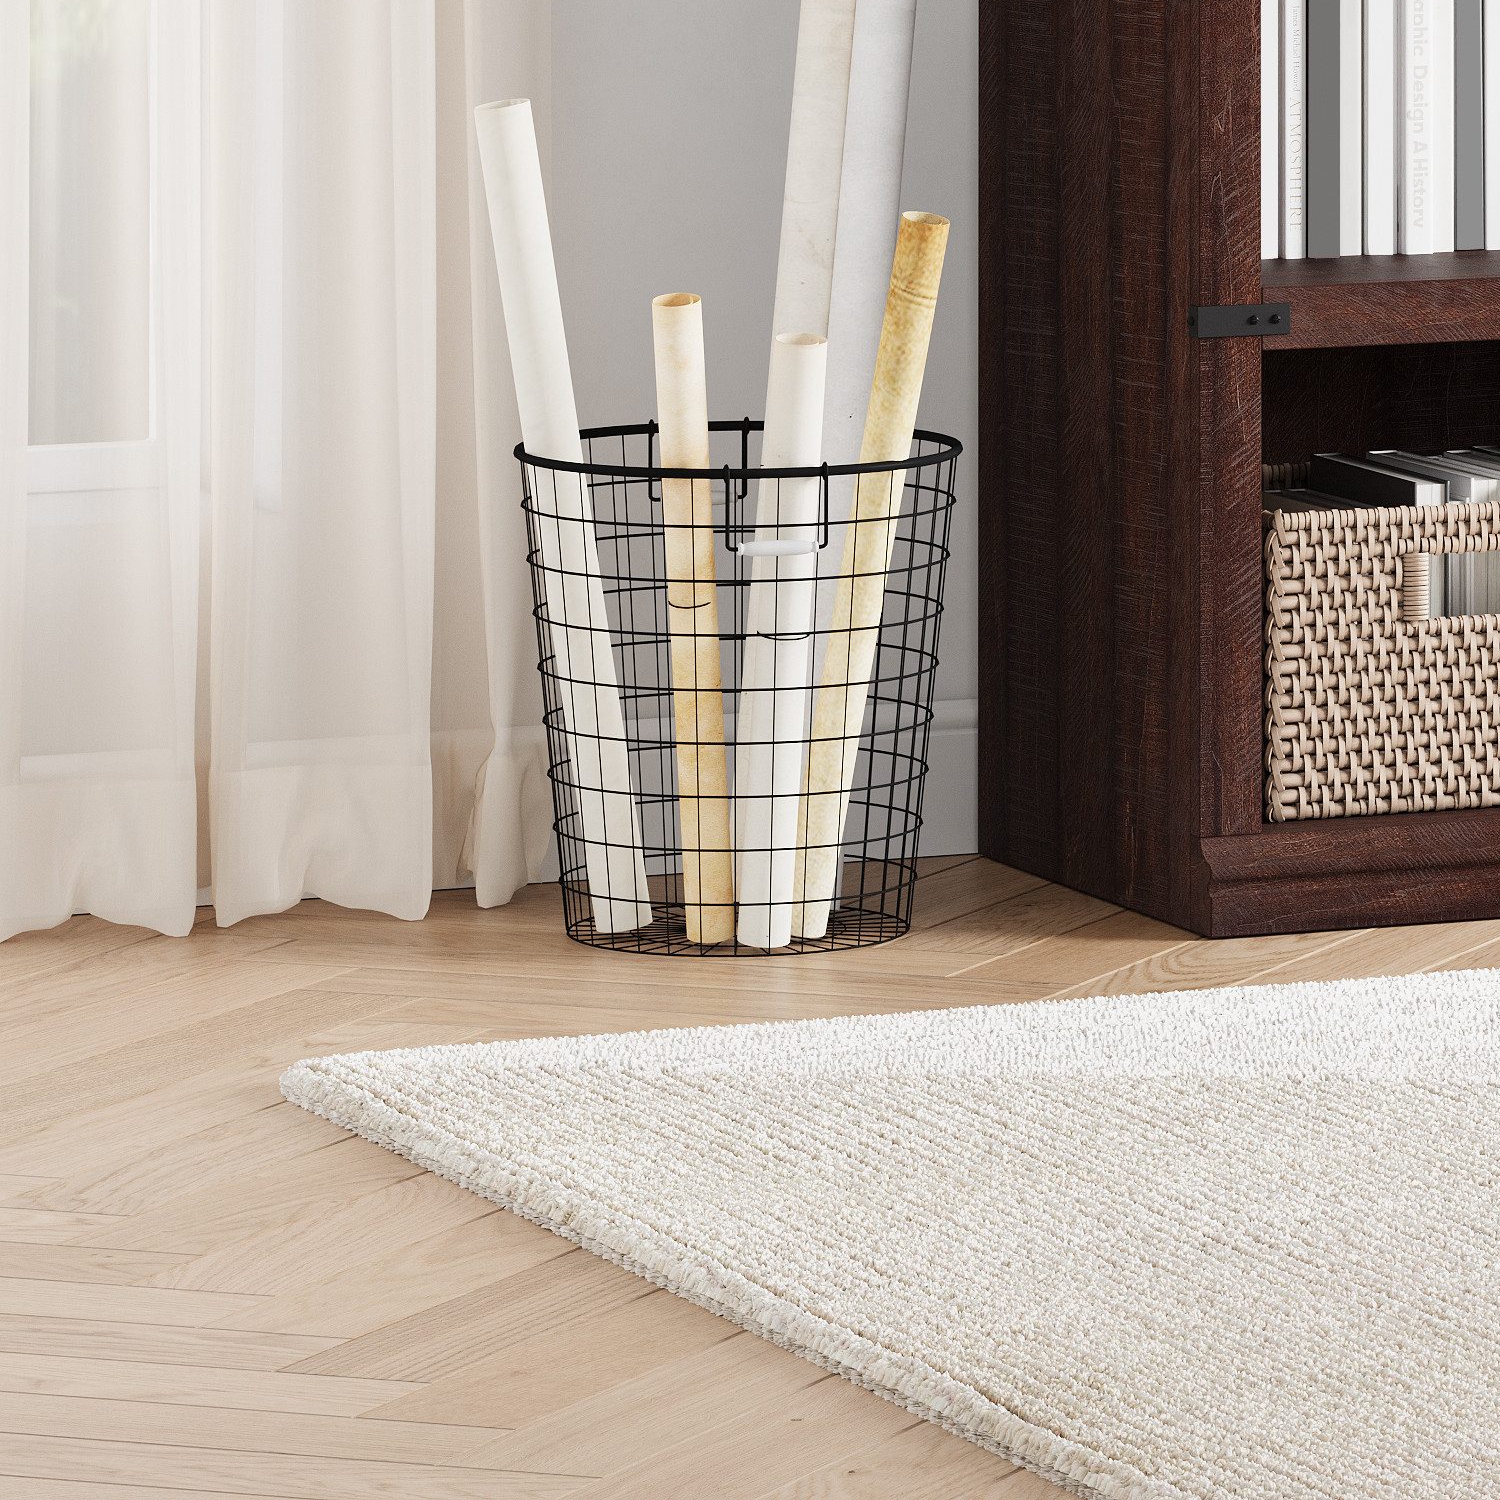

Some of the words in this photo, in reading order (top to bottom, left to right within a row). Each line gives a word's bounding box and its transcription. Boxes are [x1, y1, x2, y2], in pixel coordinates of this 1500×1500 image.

[1292, 5, 1300, 27] James
[1406, 65, 1429, 134] Design
[1289, 96, 1302, 232] ATMOSPHERE
[1413, 140, 1429, 154] A
[1412, 158, 1429, 229] History
